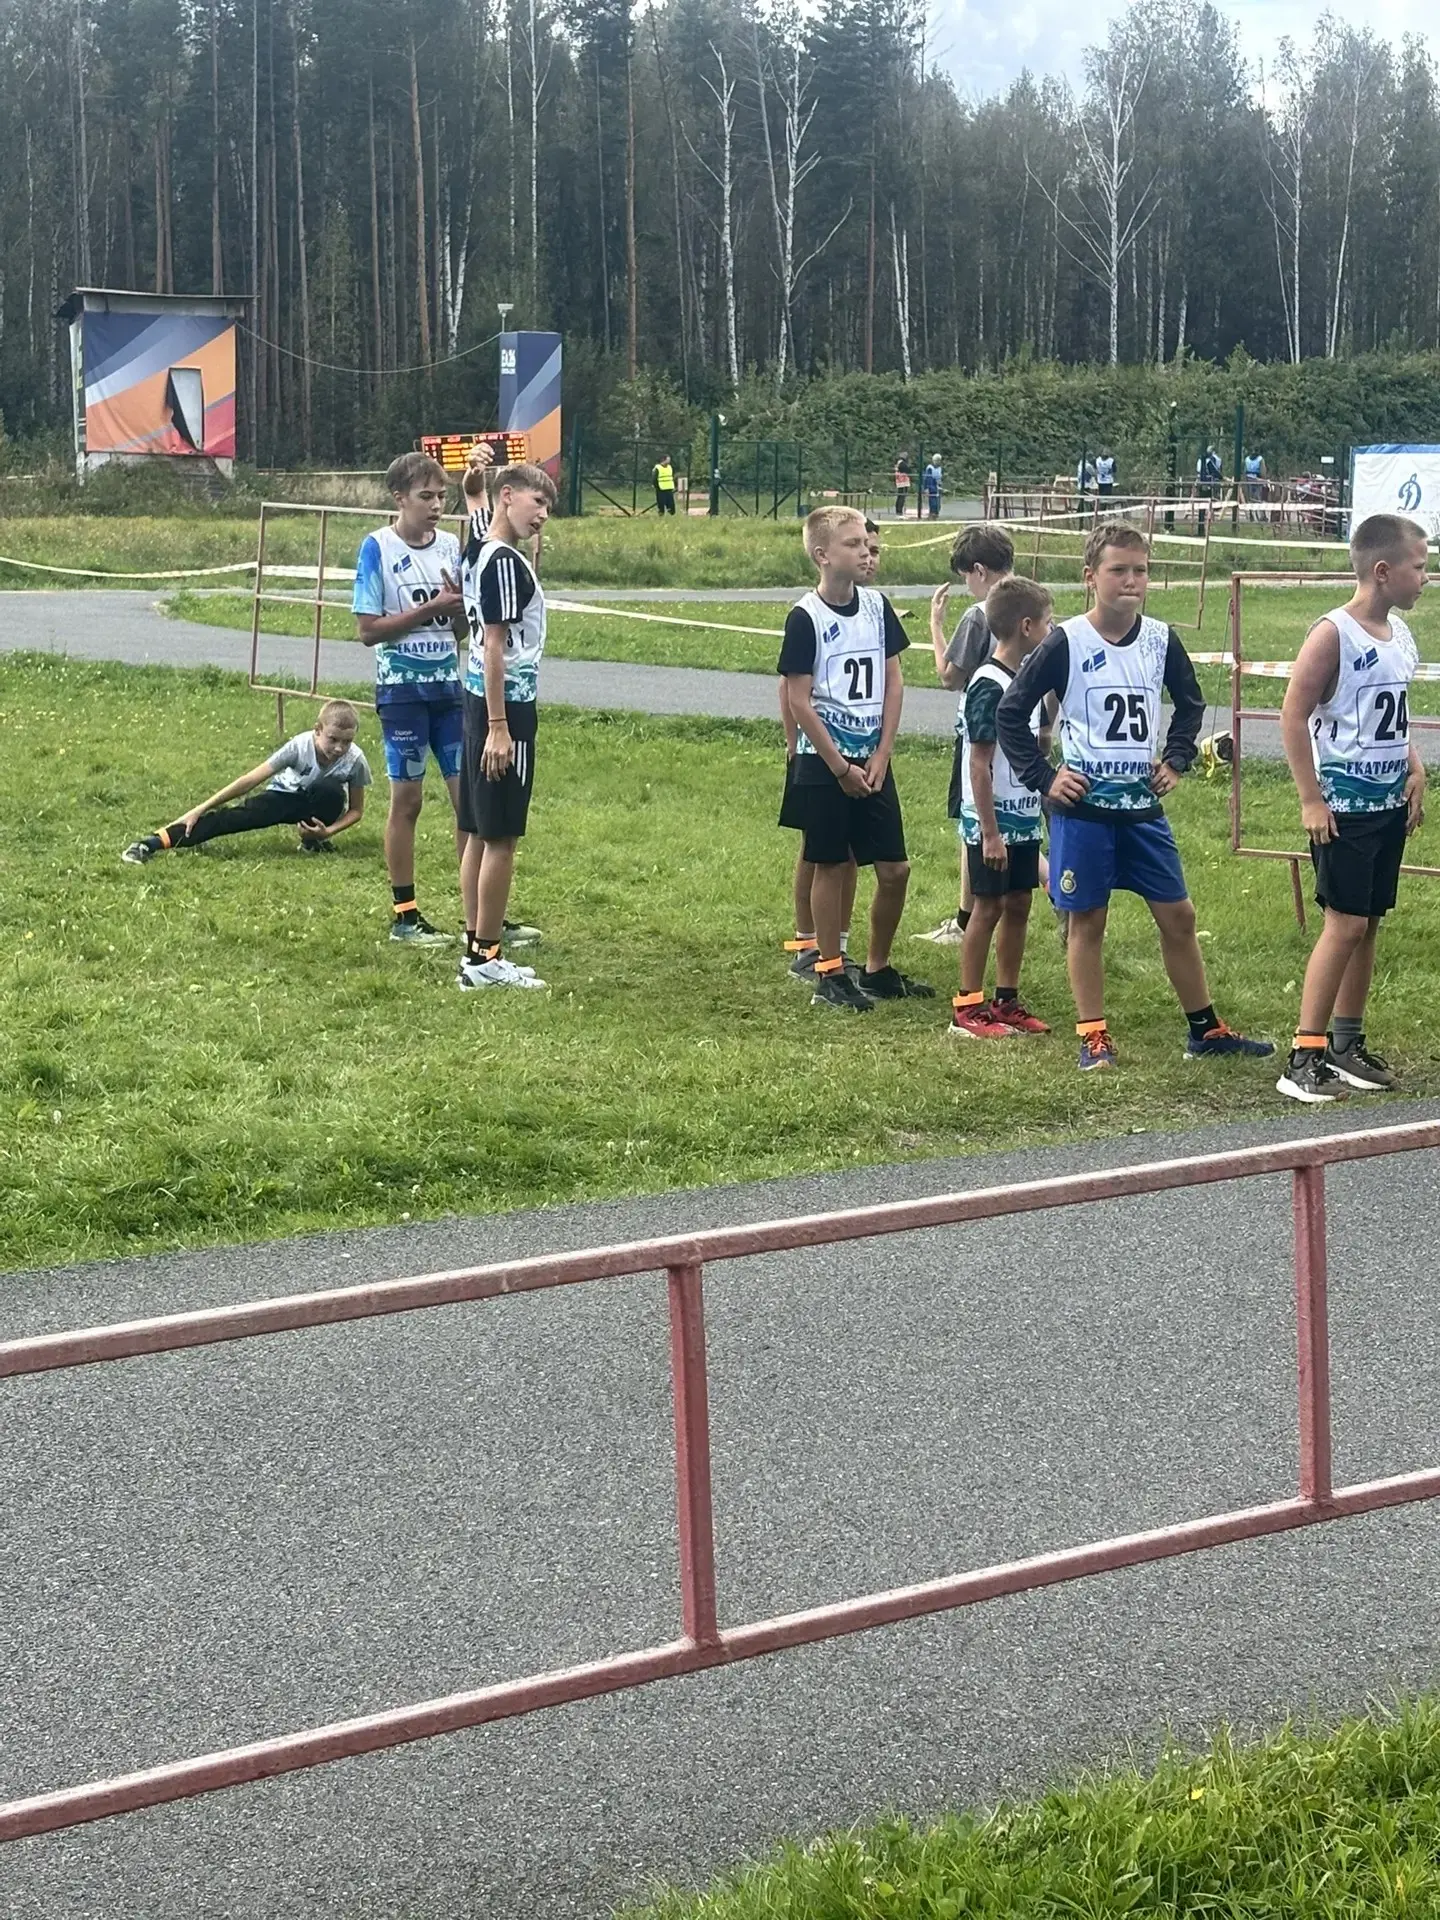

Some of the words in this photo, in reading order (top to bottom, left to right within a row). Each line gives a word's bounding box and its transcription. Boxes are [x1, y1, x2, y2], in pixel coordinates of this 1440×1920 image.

[844, 657, 874, 701] 27
[1104, 693, 1149, 742] 25
[1374, 690, 1408, 742] 24
